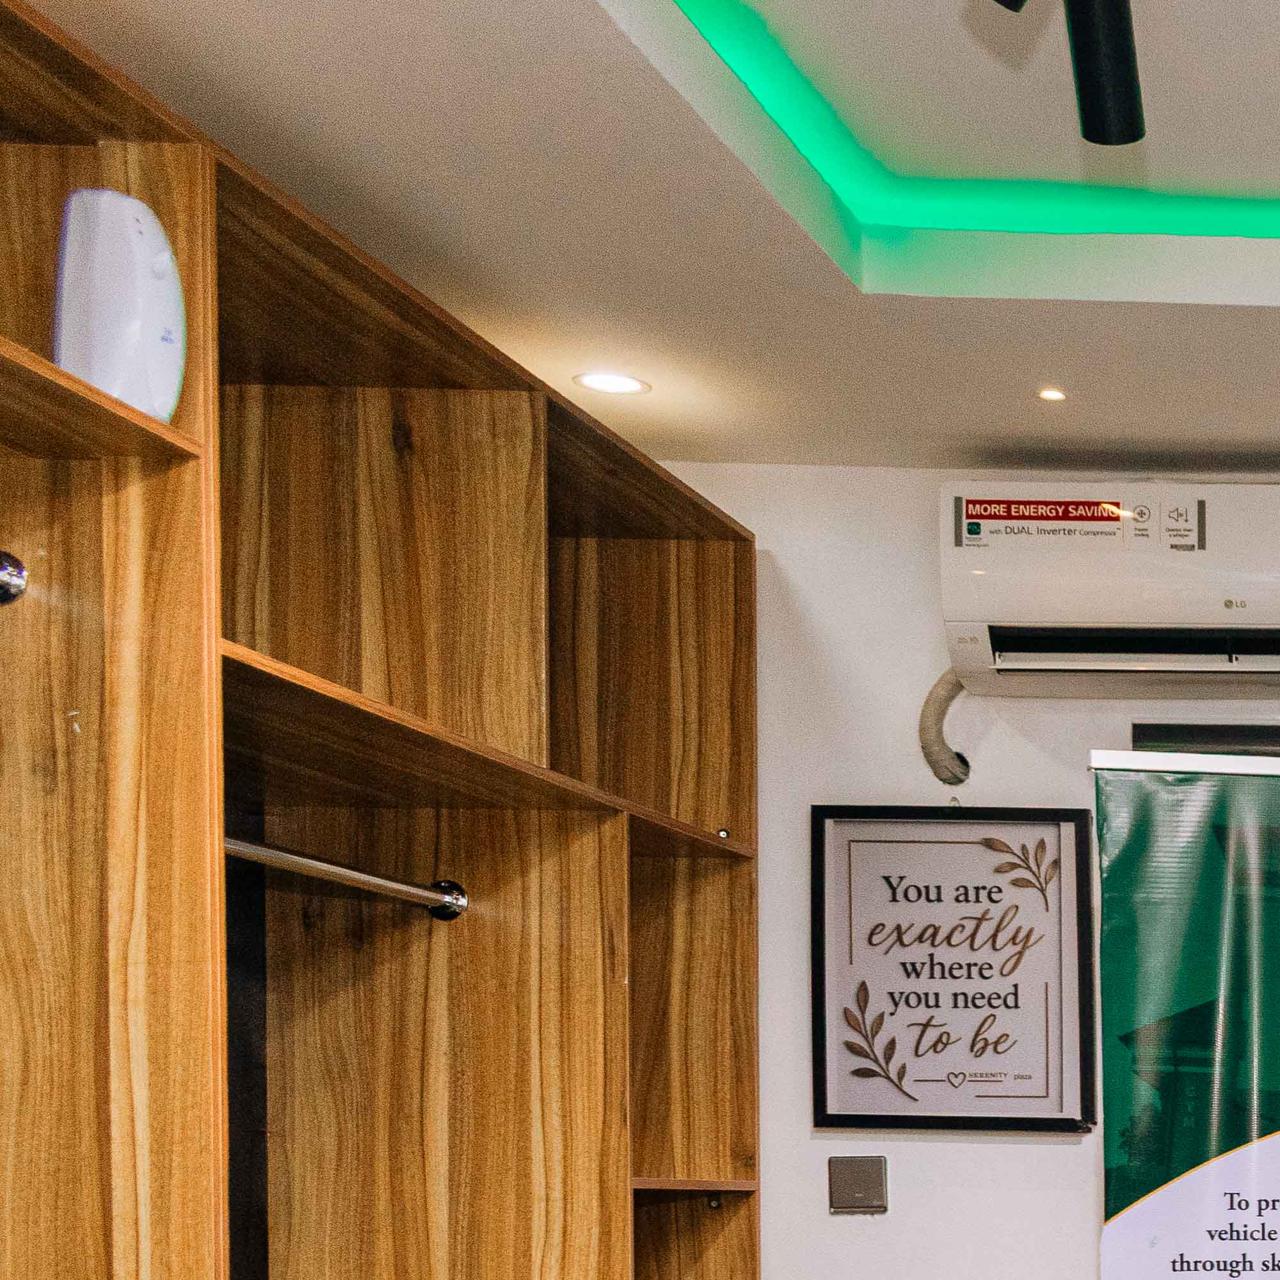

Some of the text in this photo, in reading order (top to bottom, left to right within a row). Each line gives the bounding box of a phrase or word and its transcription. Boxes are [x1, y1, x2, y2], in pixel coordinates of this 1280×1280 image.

[968, 504, 1119, 517] MORE ENERGY SAVING
[1005, 526, 1032, 535] DUAL
[1037, 526, 1077, 536] Inverter
[881, 875, 1003, 904] You are
[868, 904, 1043, 976] exactly
[899, 952, 994, 980] where
[887, 983, 1021, 1017] you need
[906, 1013, 1018, 1058] to be
[1223, 1192, 1250, 1211] To
[1206, 1222, 1278, 1241] vehicle
[1170, 1252, 1254, 1279] through
